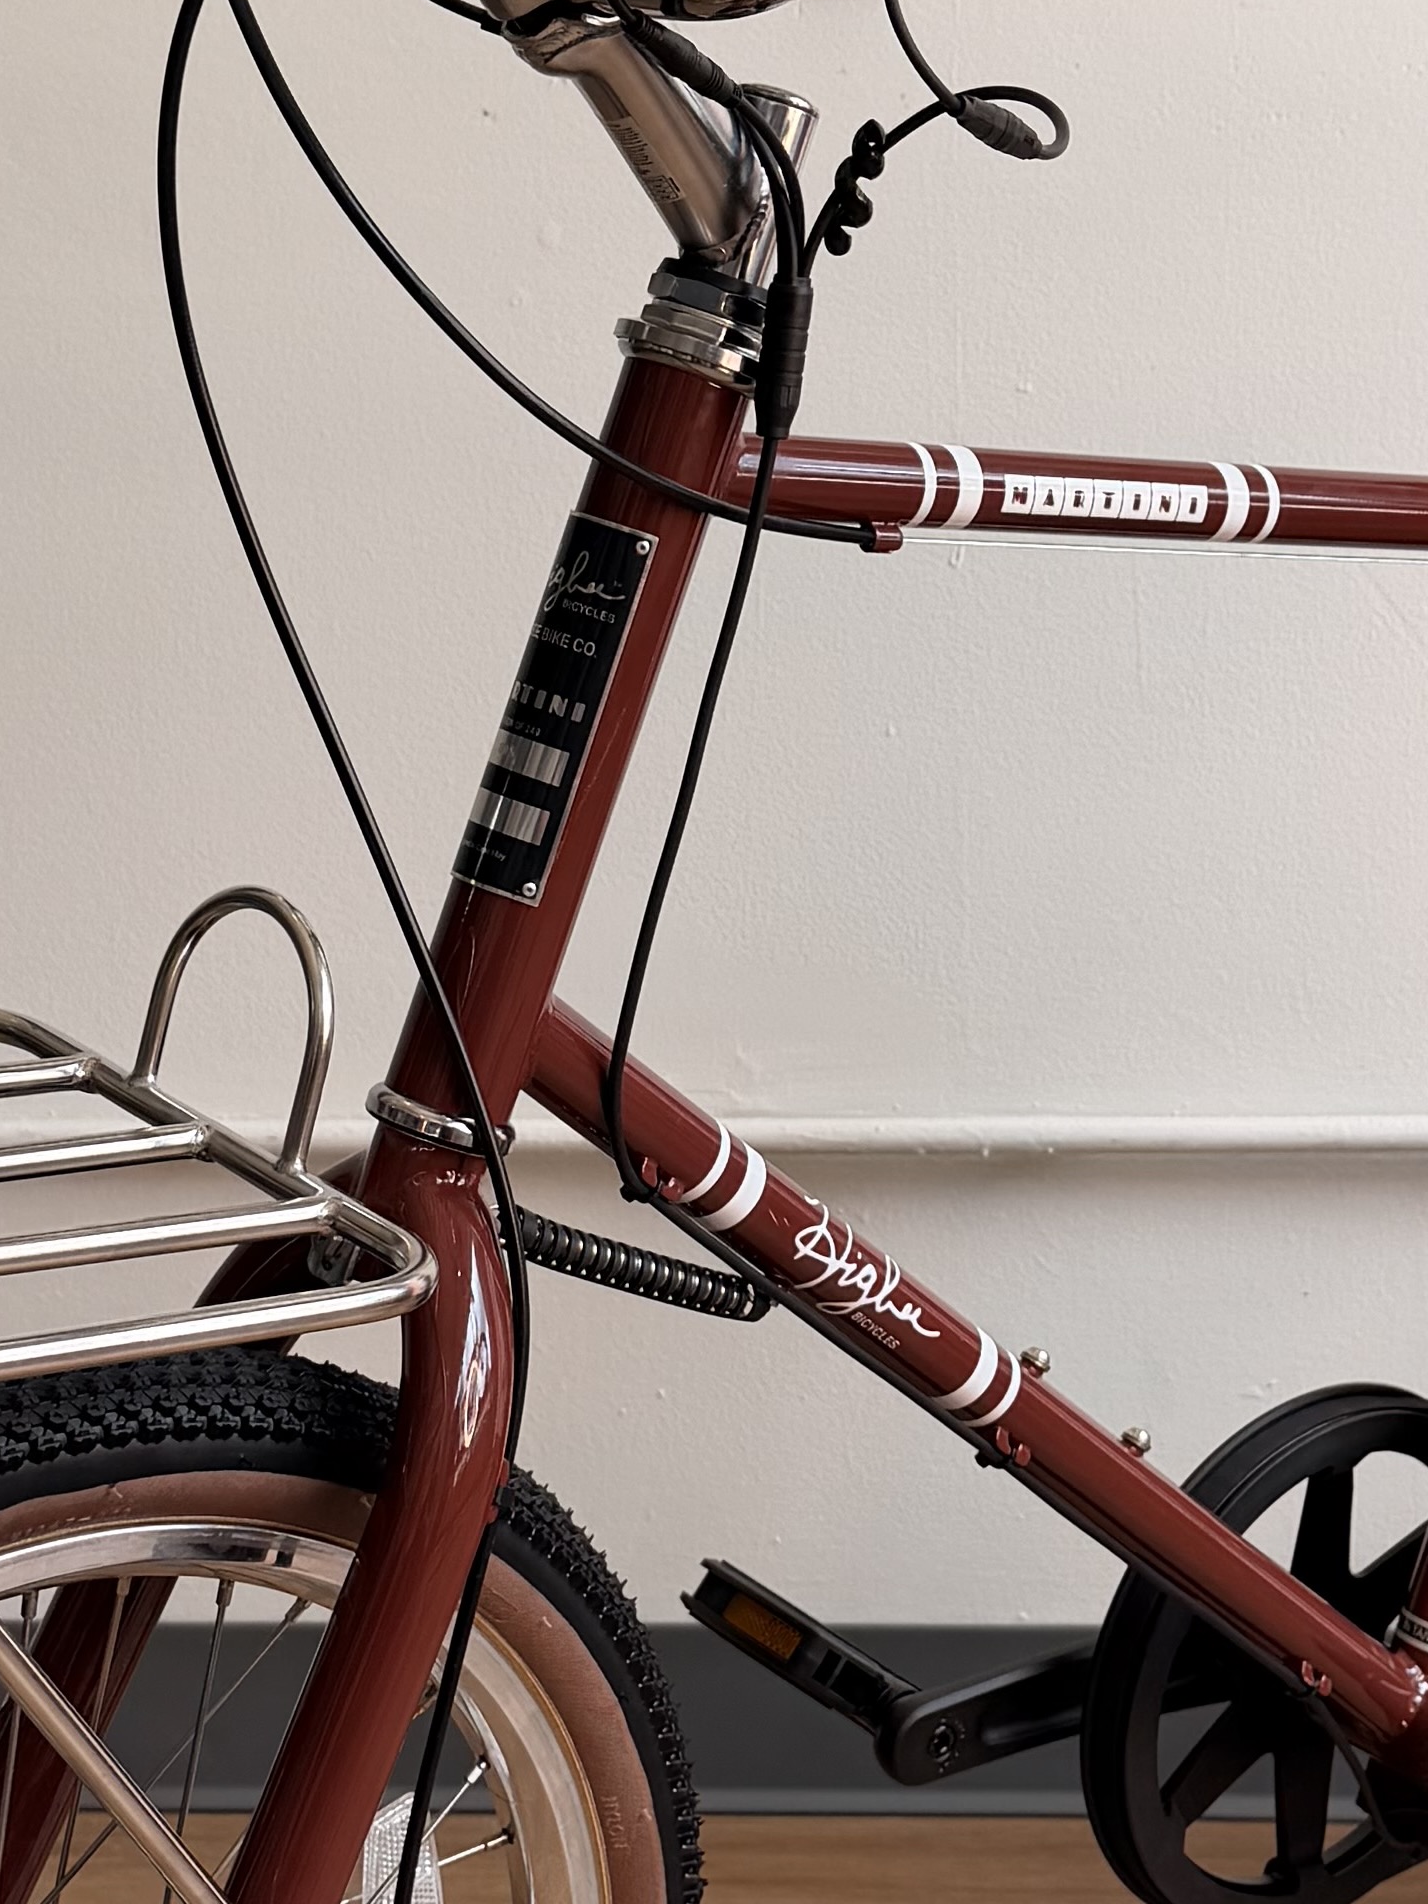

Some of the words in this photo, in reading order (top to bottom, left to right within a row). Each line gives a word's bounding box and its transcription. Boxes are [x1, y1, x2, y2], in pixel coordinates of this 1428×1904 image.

[1010, 484, 1200, 516] MARTINI
[562, 598, 615, 624] BICYCLES
[541, 626, 572, 649] BIKE
[573, 638, 597, 658] CO.
[850, 1310, 901, 1351] BICYCLES
